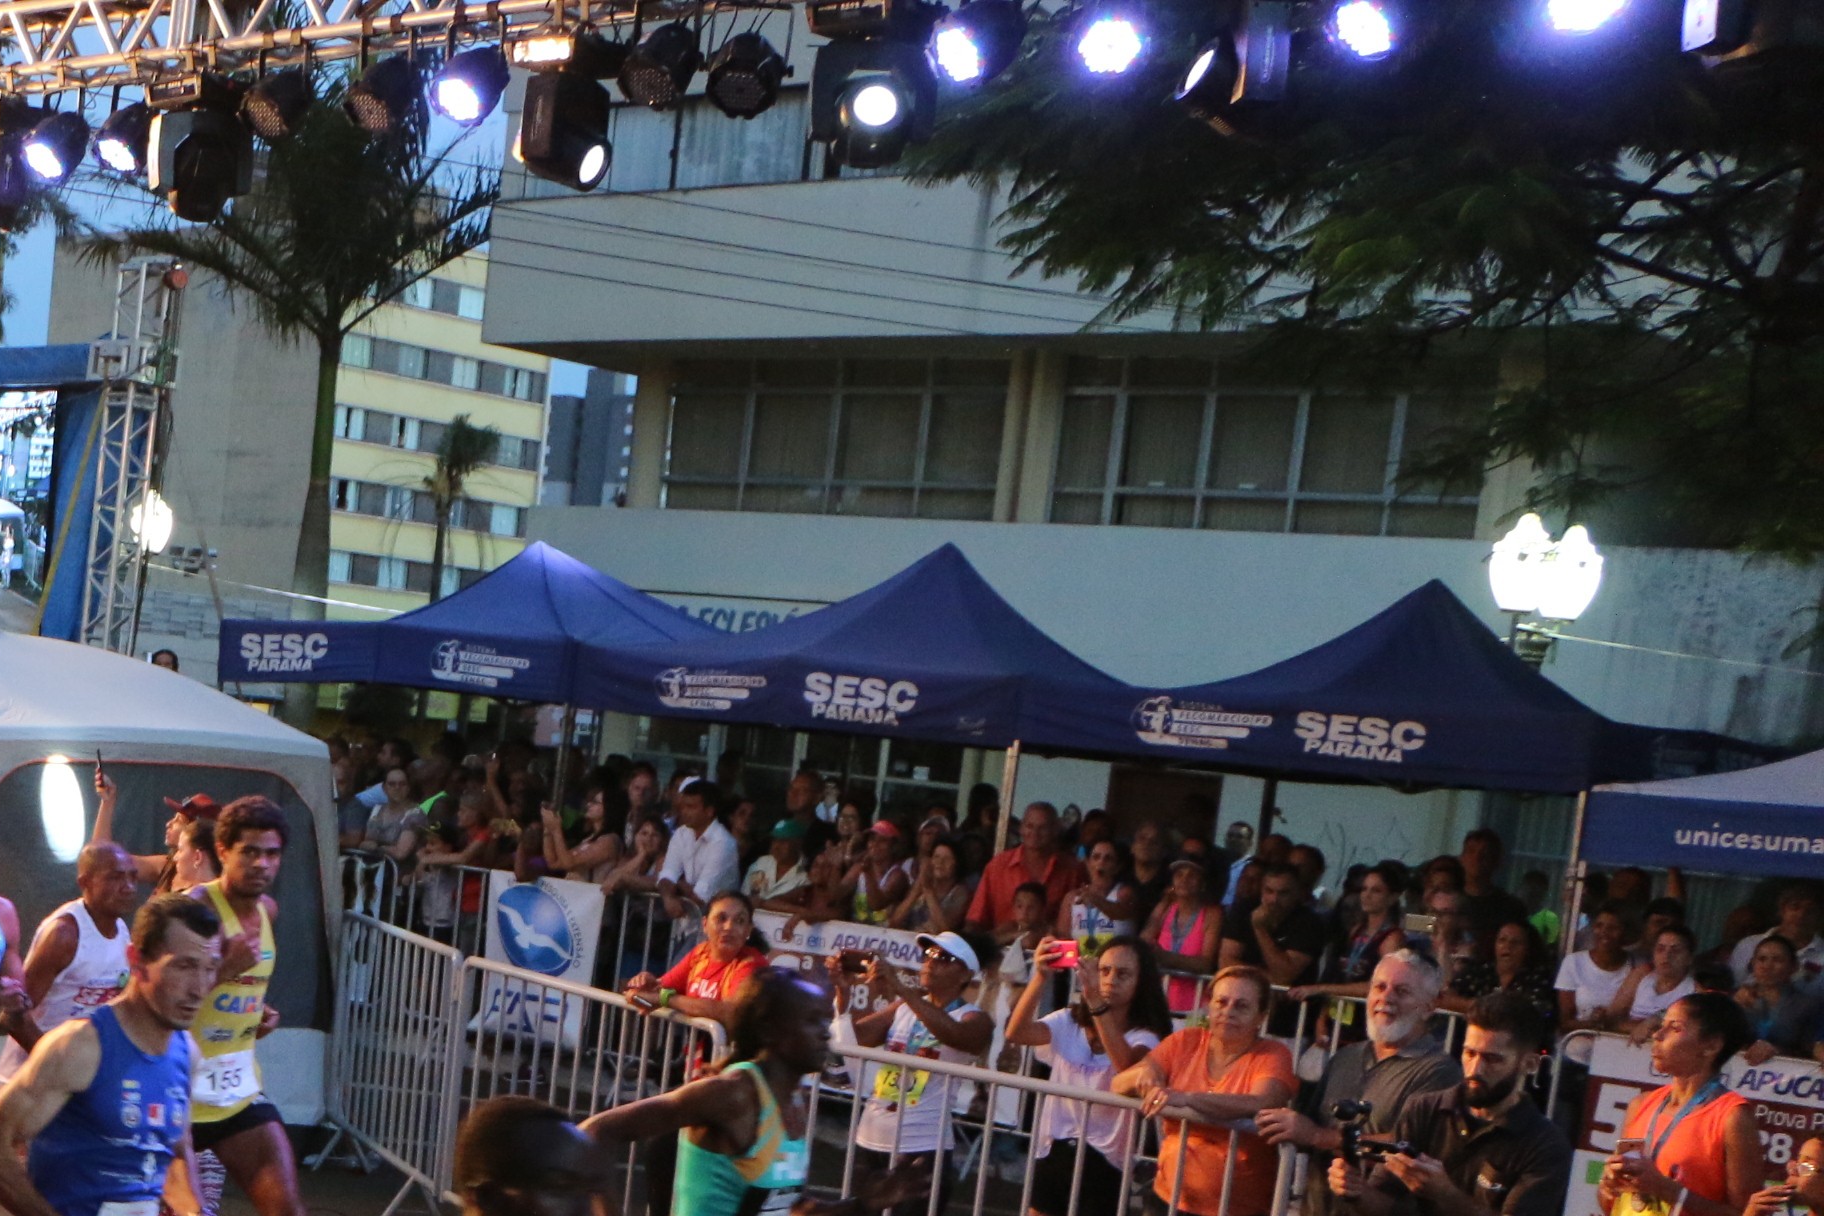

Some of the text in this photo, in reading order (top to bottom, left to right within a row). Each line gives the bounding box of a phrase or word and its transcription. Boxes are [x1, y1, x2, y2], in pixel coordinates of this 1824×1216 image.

[240, 632, 329, 660] SESC
[802, 671, 919, 713] SESC
[1293, 710, 1426, 751] SESC
[1755, 1104, 1806, 1129] Prova
